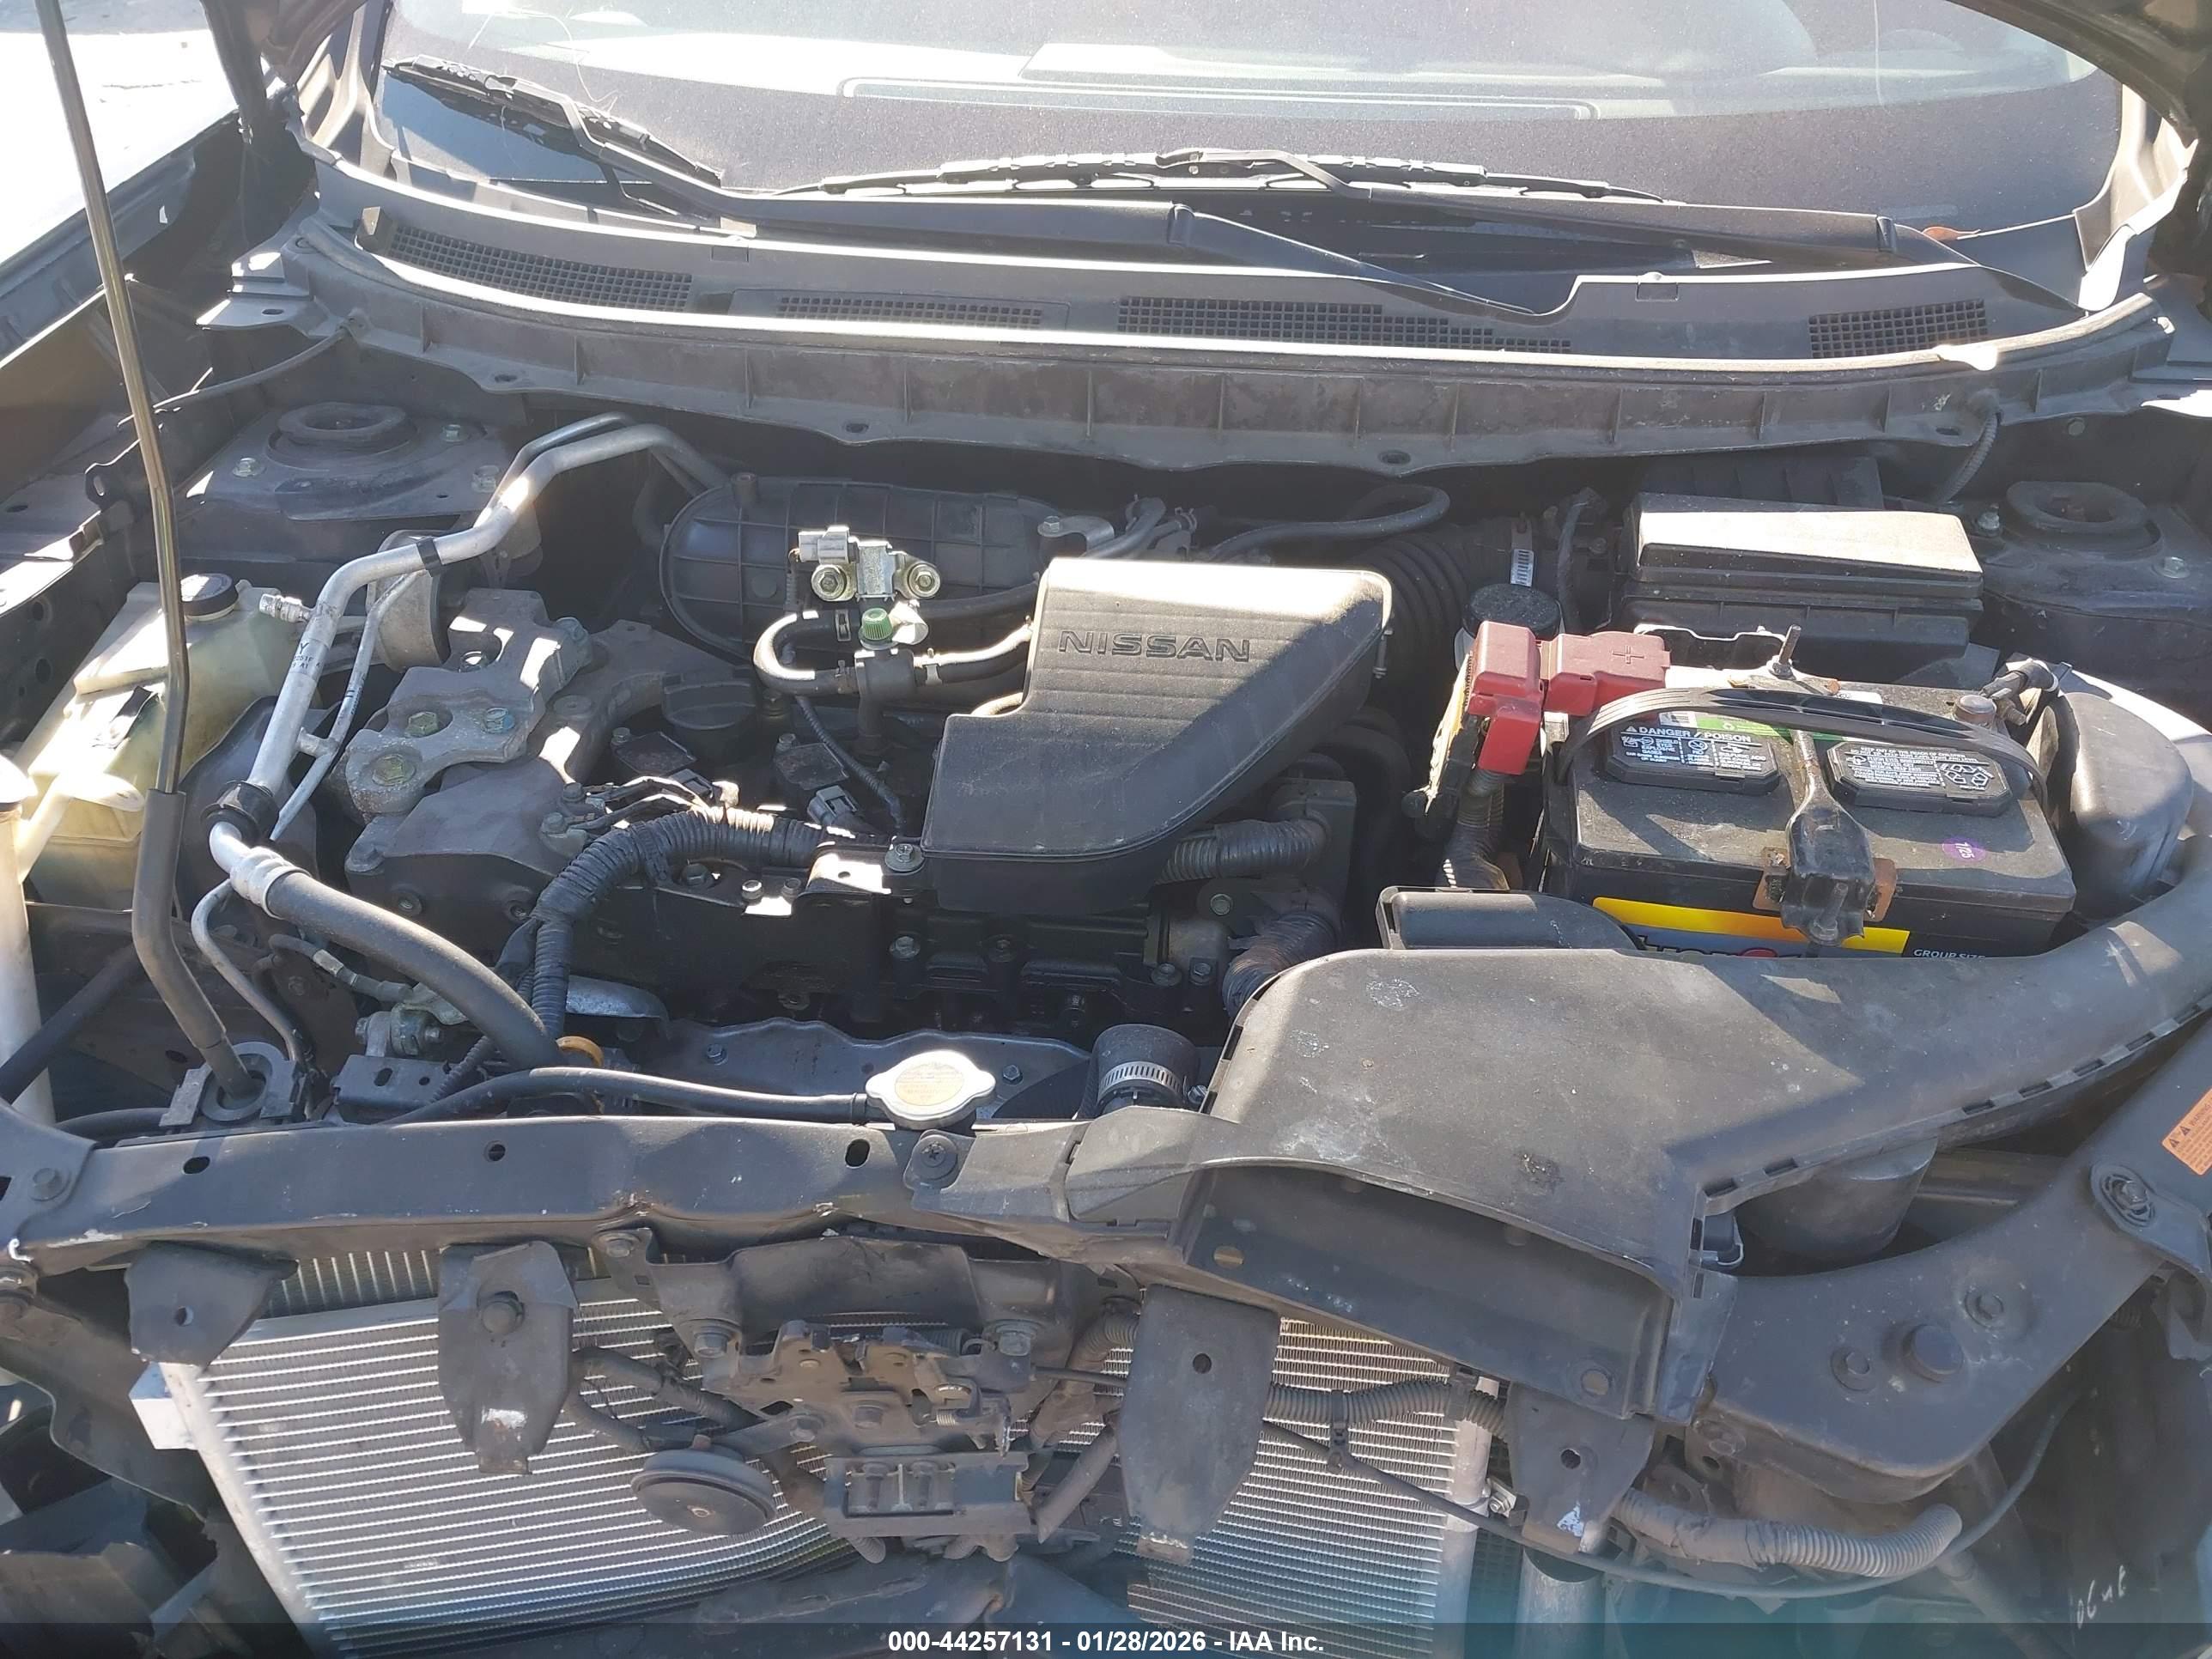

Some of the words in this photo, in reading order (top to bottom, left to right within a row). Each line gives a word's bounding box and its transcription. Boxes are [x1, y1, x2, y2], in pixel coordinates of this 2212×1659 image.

[1059, 629, 1250, 663] NISSAN
[1638, 726, 1691, 738] DANGER
[1703, 732, 1752, 743] POISON
[1913, 949, 1957, 958] GROUP
